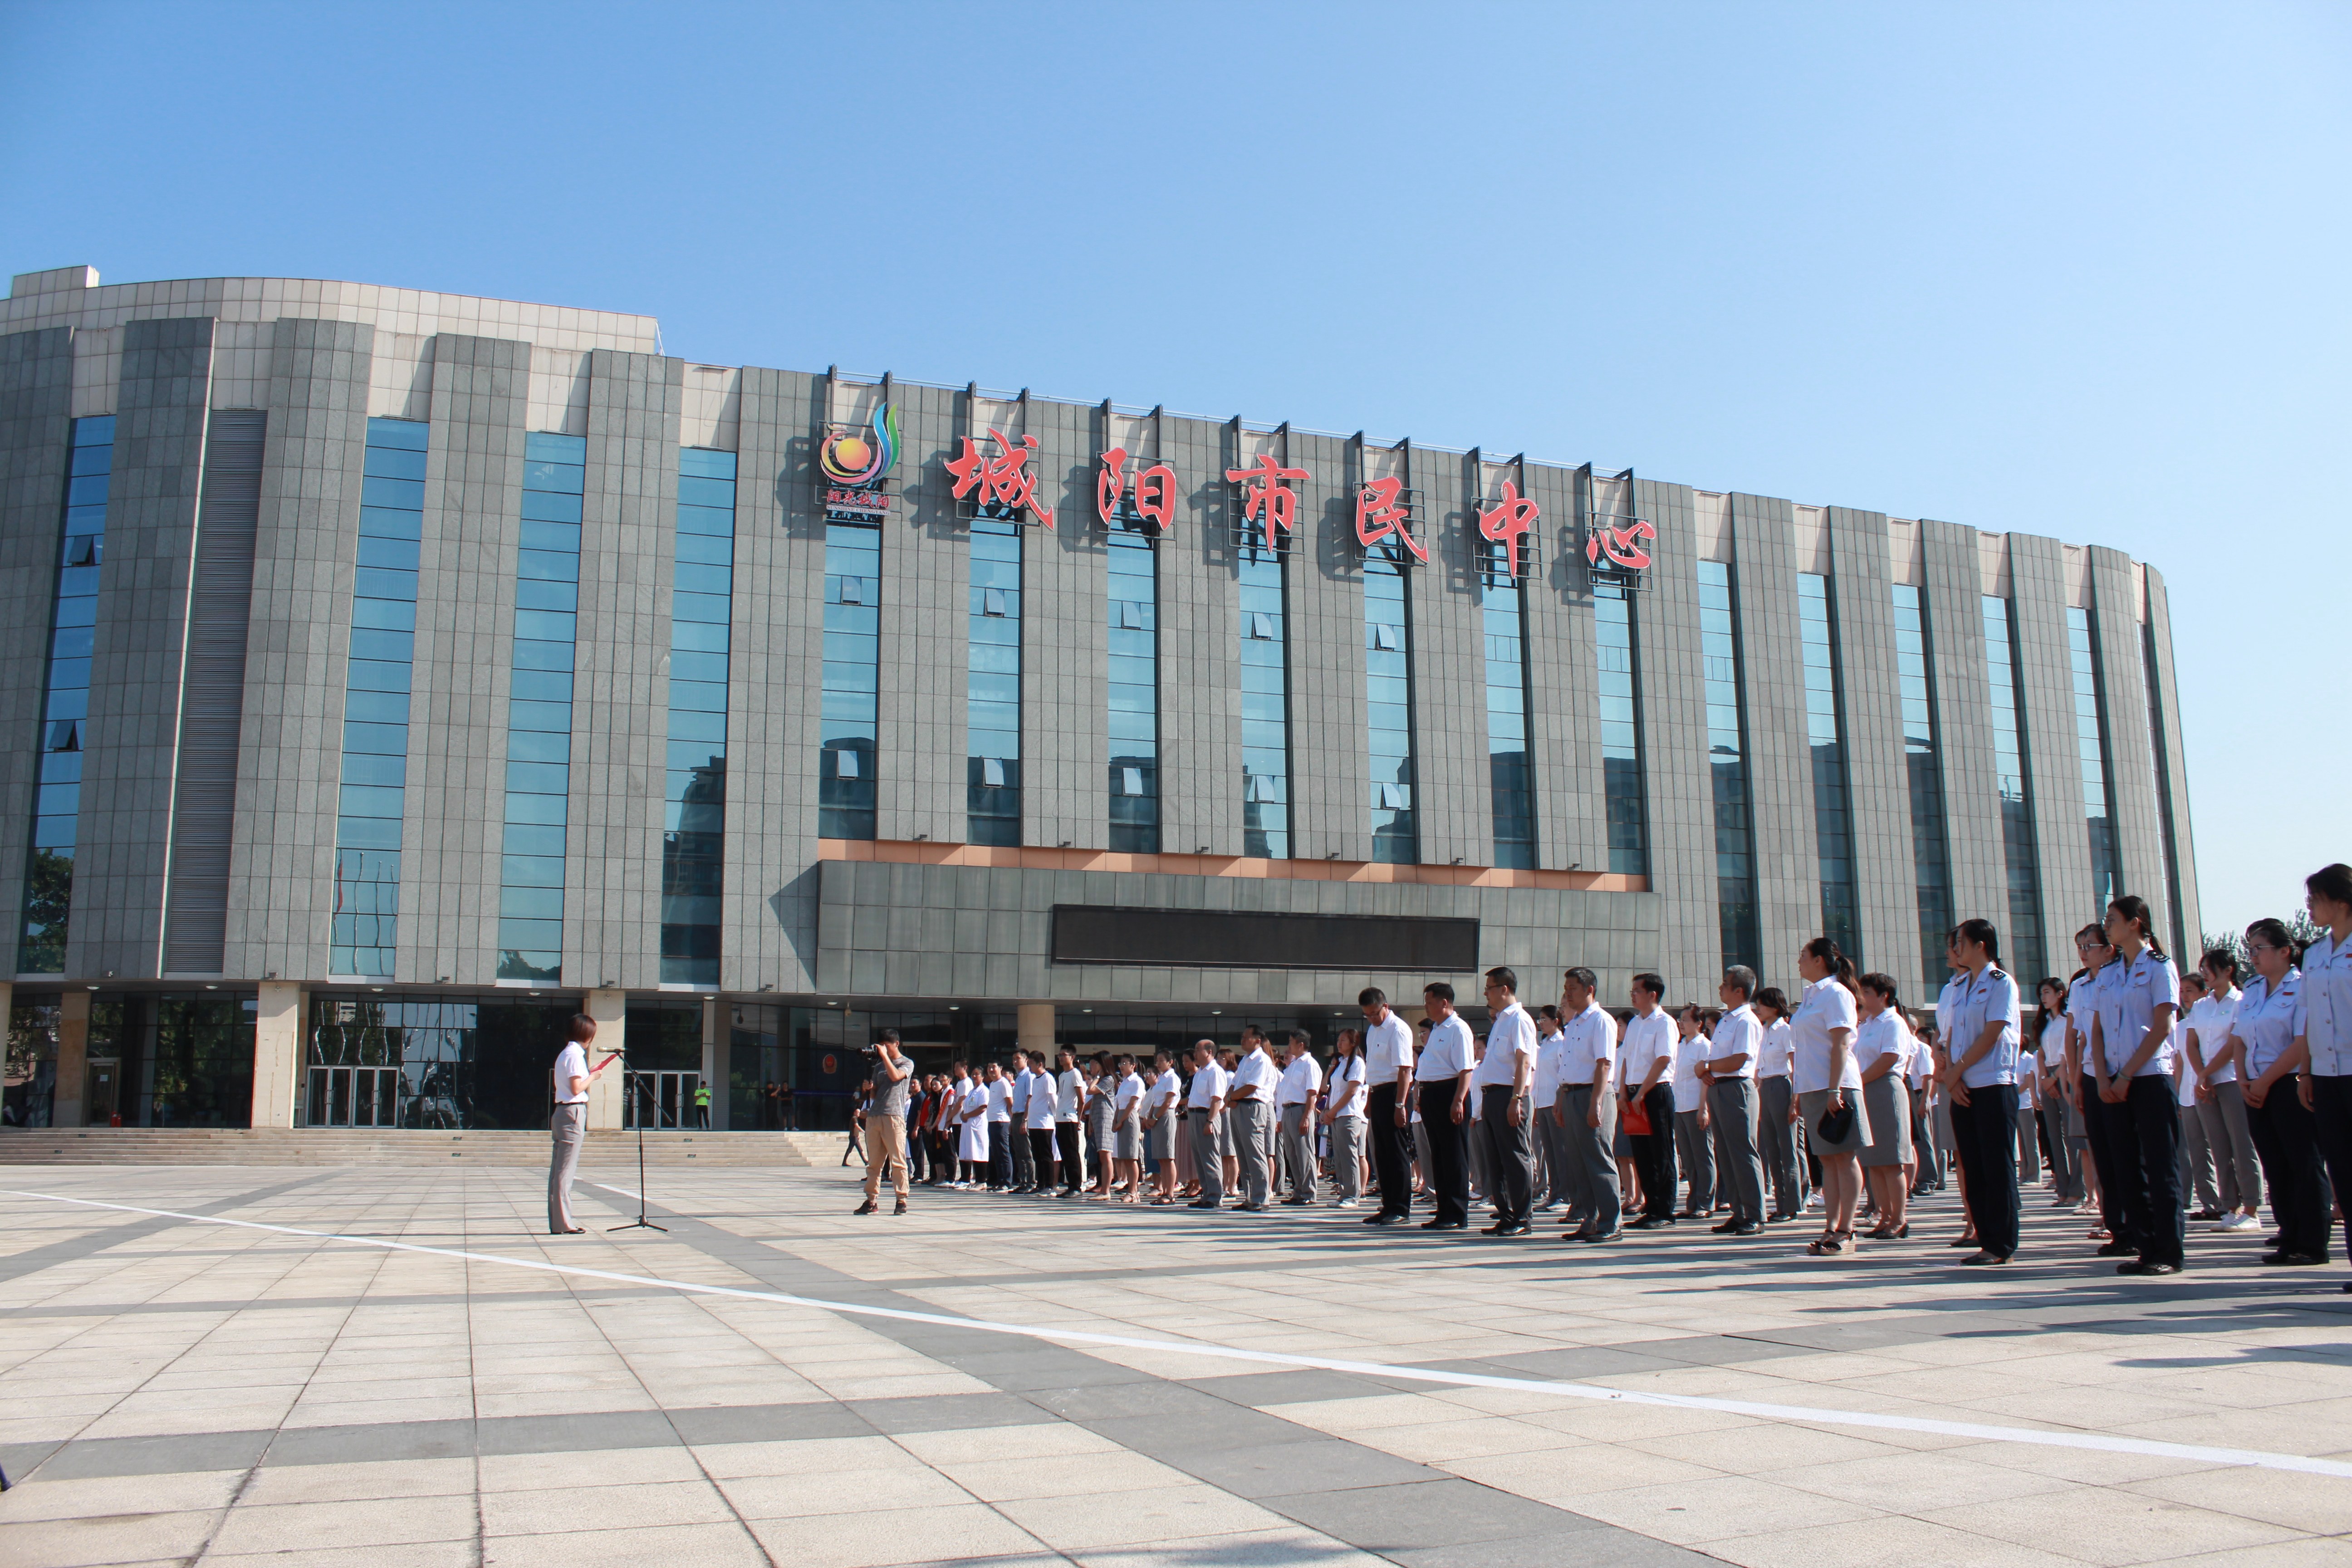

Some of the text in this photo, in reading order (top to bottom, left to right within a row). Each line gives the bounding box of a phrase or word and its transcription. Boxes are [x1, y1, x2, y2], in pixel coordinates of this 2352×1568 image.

[944, 427, 1656, 579] 城阳市民中心
